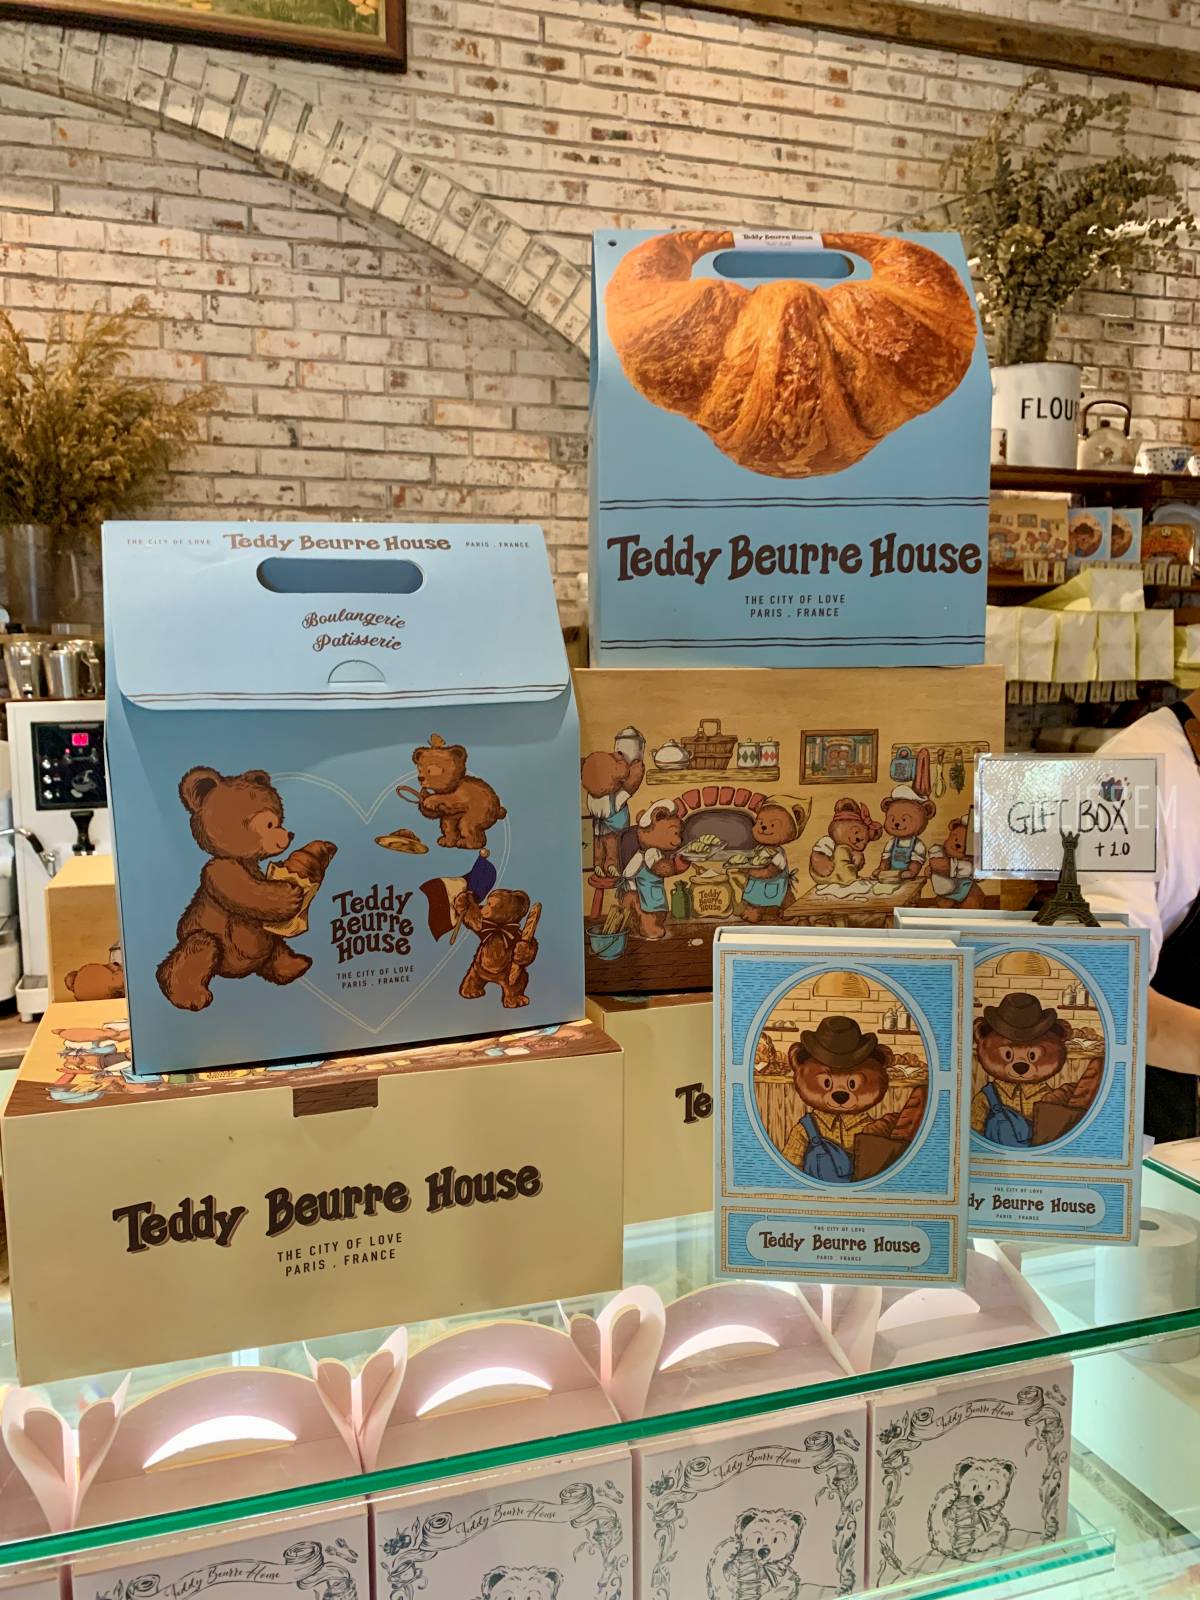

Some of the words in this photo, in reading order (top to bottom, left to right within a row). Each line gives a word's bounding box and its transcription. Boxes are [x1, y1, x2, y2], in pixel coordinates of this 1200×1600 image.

[223, 533, 295, 552] Teddy
[299, 534, 380, 550] Beurre
[384, 534, 452, 551] House
[607, 534, 722, 585] Teddy
[728, 534, 863, 580] Beurre
[869, 532, 982, 578] House
[744, 595, 764, 605] THE
[769, 595, 794, 604] CITY
[799, 595, 812, 604] OF
[818, 594, 846, 604] LOVE
[301, 607, 406, 629] Boulangerie
[750, 608, 782, 618] PARIS
[797, 607, 840, 618] FRANCE
[312, 631, 402, 652] Patisserie
[1007, 799, 1069, 836] GIFT
[1079, 799, 1128, 835] BOX
[332, 883, 413, 917] Teddy
[699, 889, 721, 899] Teddy
[330, 912, 414, 944] Beurre
[336, 933, 411, 963] House
[337, 972, 352, 980] THE
[356, 970, 375, 978] CITY
[380, 968, 390, 976] OF
[394, 965, 414, 974] LOVE
[342, 980, 367, 989] PARIS
[378, 975, 410, 985] FRANCE
[112, 1194, 249, 1253] Teddy
[264, 1180, 411, 1237] Beurre
[424, 1165, 543, 1213] House
[992, 1194, 1044, 1212] Beurre
[1051, 1197, 1096, 1214] House
[277, 1249, 302, 1263] THE
[309, 1241, 339, 1256] CITY
[346, 1237, 364, 1251] OF
[369, 1232, 403, 1247] LOVE
[759, 1231, 805, 1251] Teddy
[812, 1234, 867, 1251] Beurre
[874, 1236, 921, 1253] House
[285, 1259, 326, 1277] PARIS
[344, 1249, 396, 1266] FRANCE
[207, 1565, 243, 1584] Beurre
[245, 1563, 280, 1582] House
